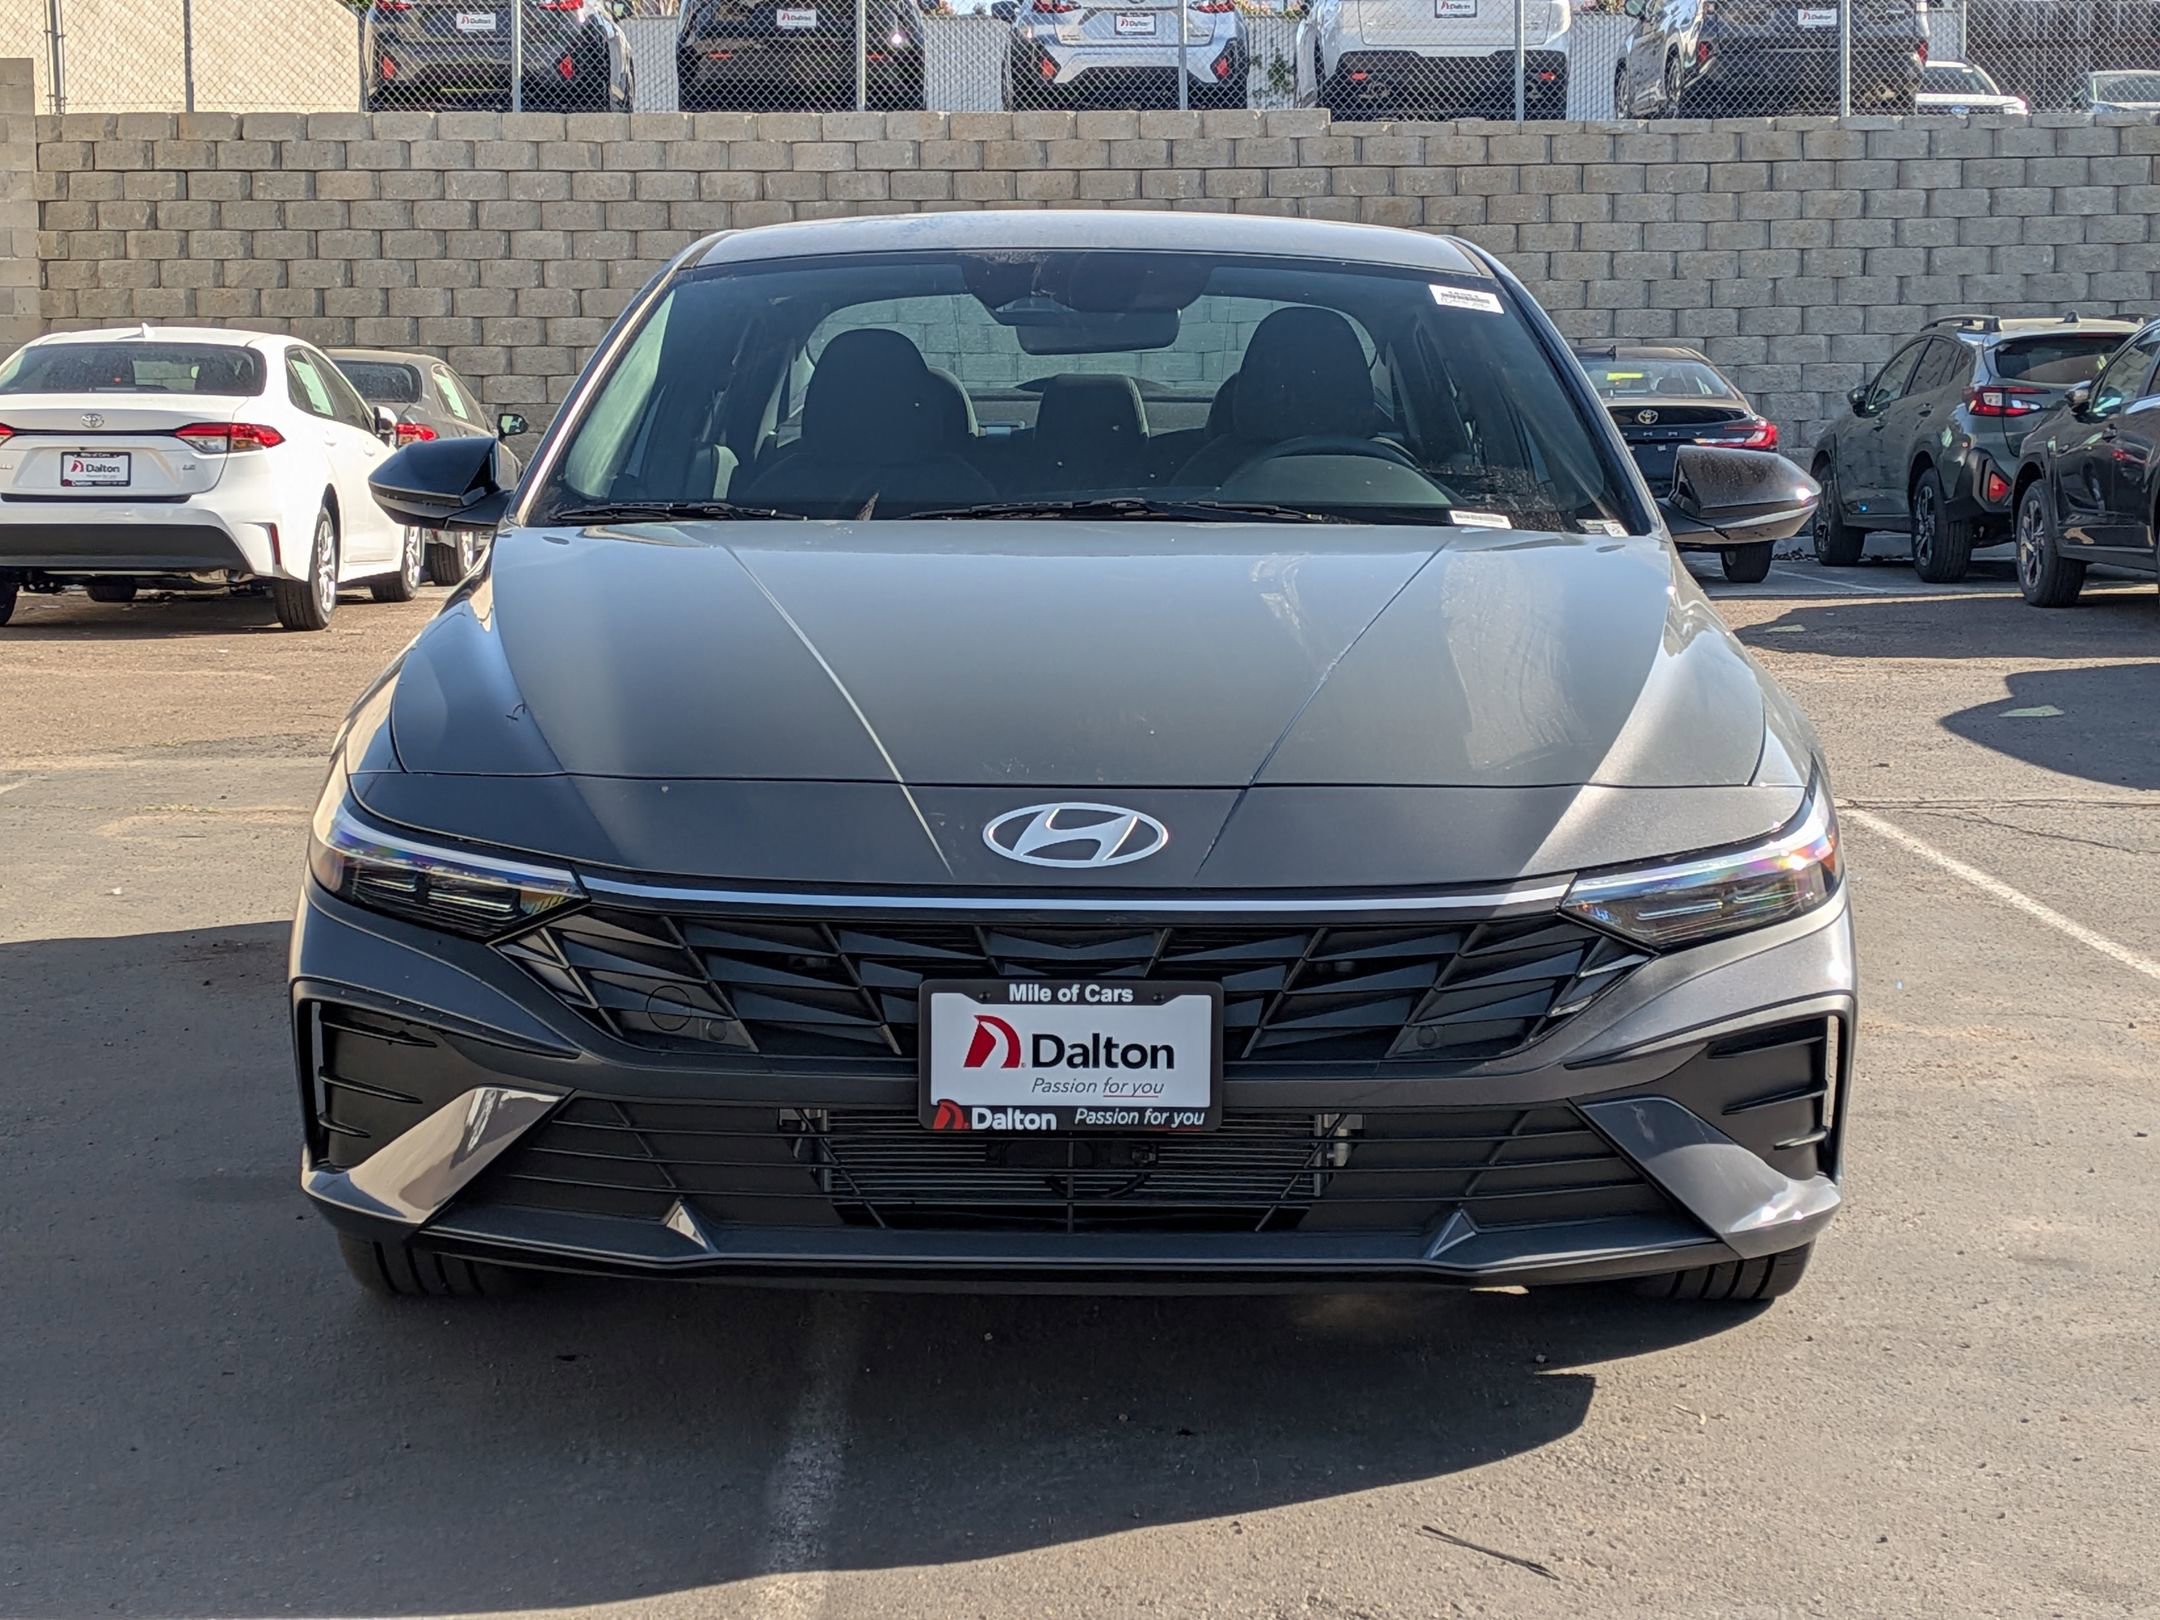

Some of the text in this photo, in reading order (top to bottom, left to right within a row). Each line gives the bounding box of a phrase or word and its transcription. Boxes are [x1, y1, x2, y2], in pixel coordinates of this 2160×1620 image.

[86, 463, 120, 473] Dalton
[1008, 983, 1134, 1003] Mile of Cars
[1031, 1032, 1175, 1069] Dalton
[1031, 1077, 1165, 1097] Passion for you
[971, 1107, 1058, 1130] Dalton
[1074, 1108, 1205, 1128] Passion for you
